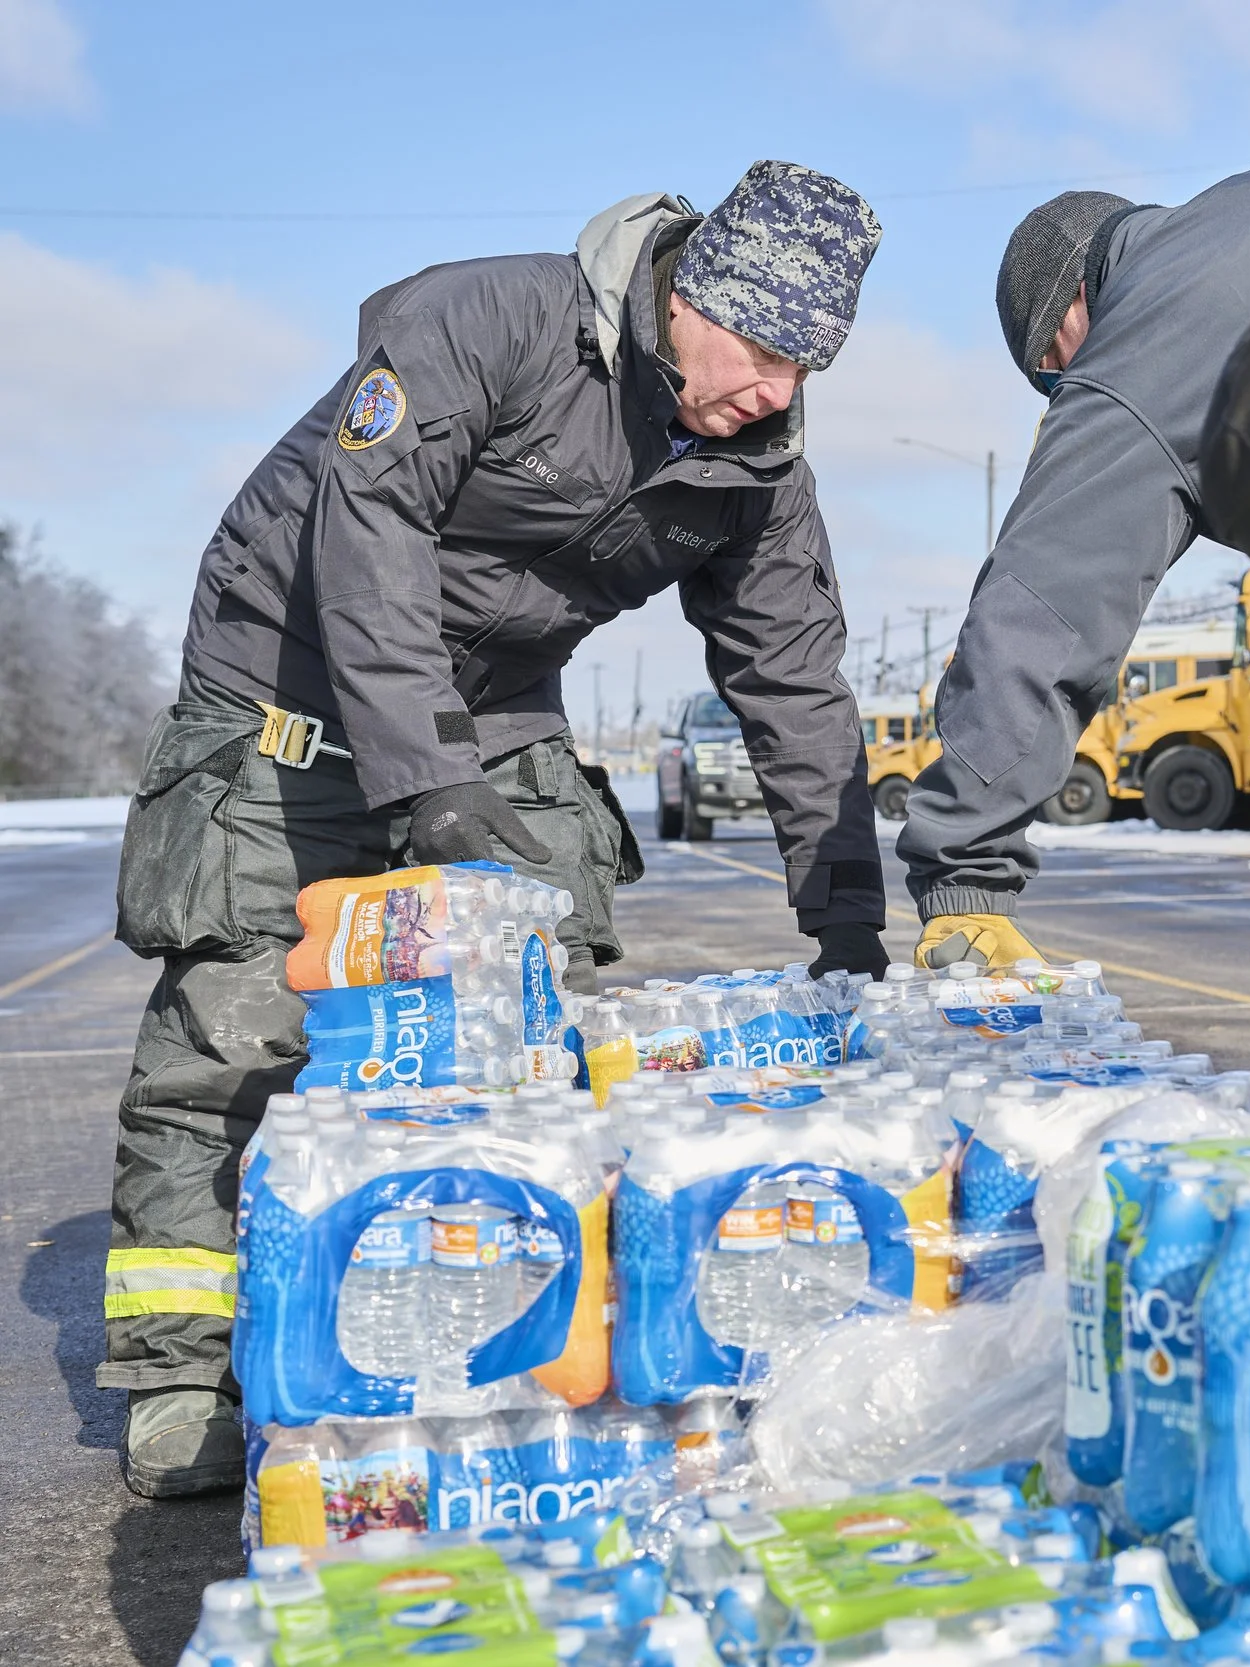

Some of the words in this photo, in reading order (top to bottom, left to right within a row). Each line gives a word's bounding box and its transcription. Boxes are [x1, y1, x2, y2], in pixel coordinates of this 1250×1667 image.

[812, 324, 845, 348] FIRE
[666, 525, 706, 549] Water
[356, 901, 369, 942] VACATION
[364, 901, 381, 936] WIN
[366, 941, 374, 982] UNIVERSAL
[529, 954, 547, 1041] niagara
[358, 987, 434, 1090] niag
[372, 1008, 385, 1053] PURIFIED
[713, 1034, 841, 1068] niagara
[437, 1475, 659, 1531] niagara
